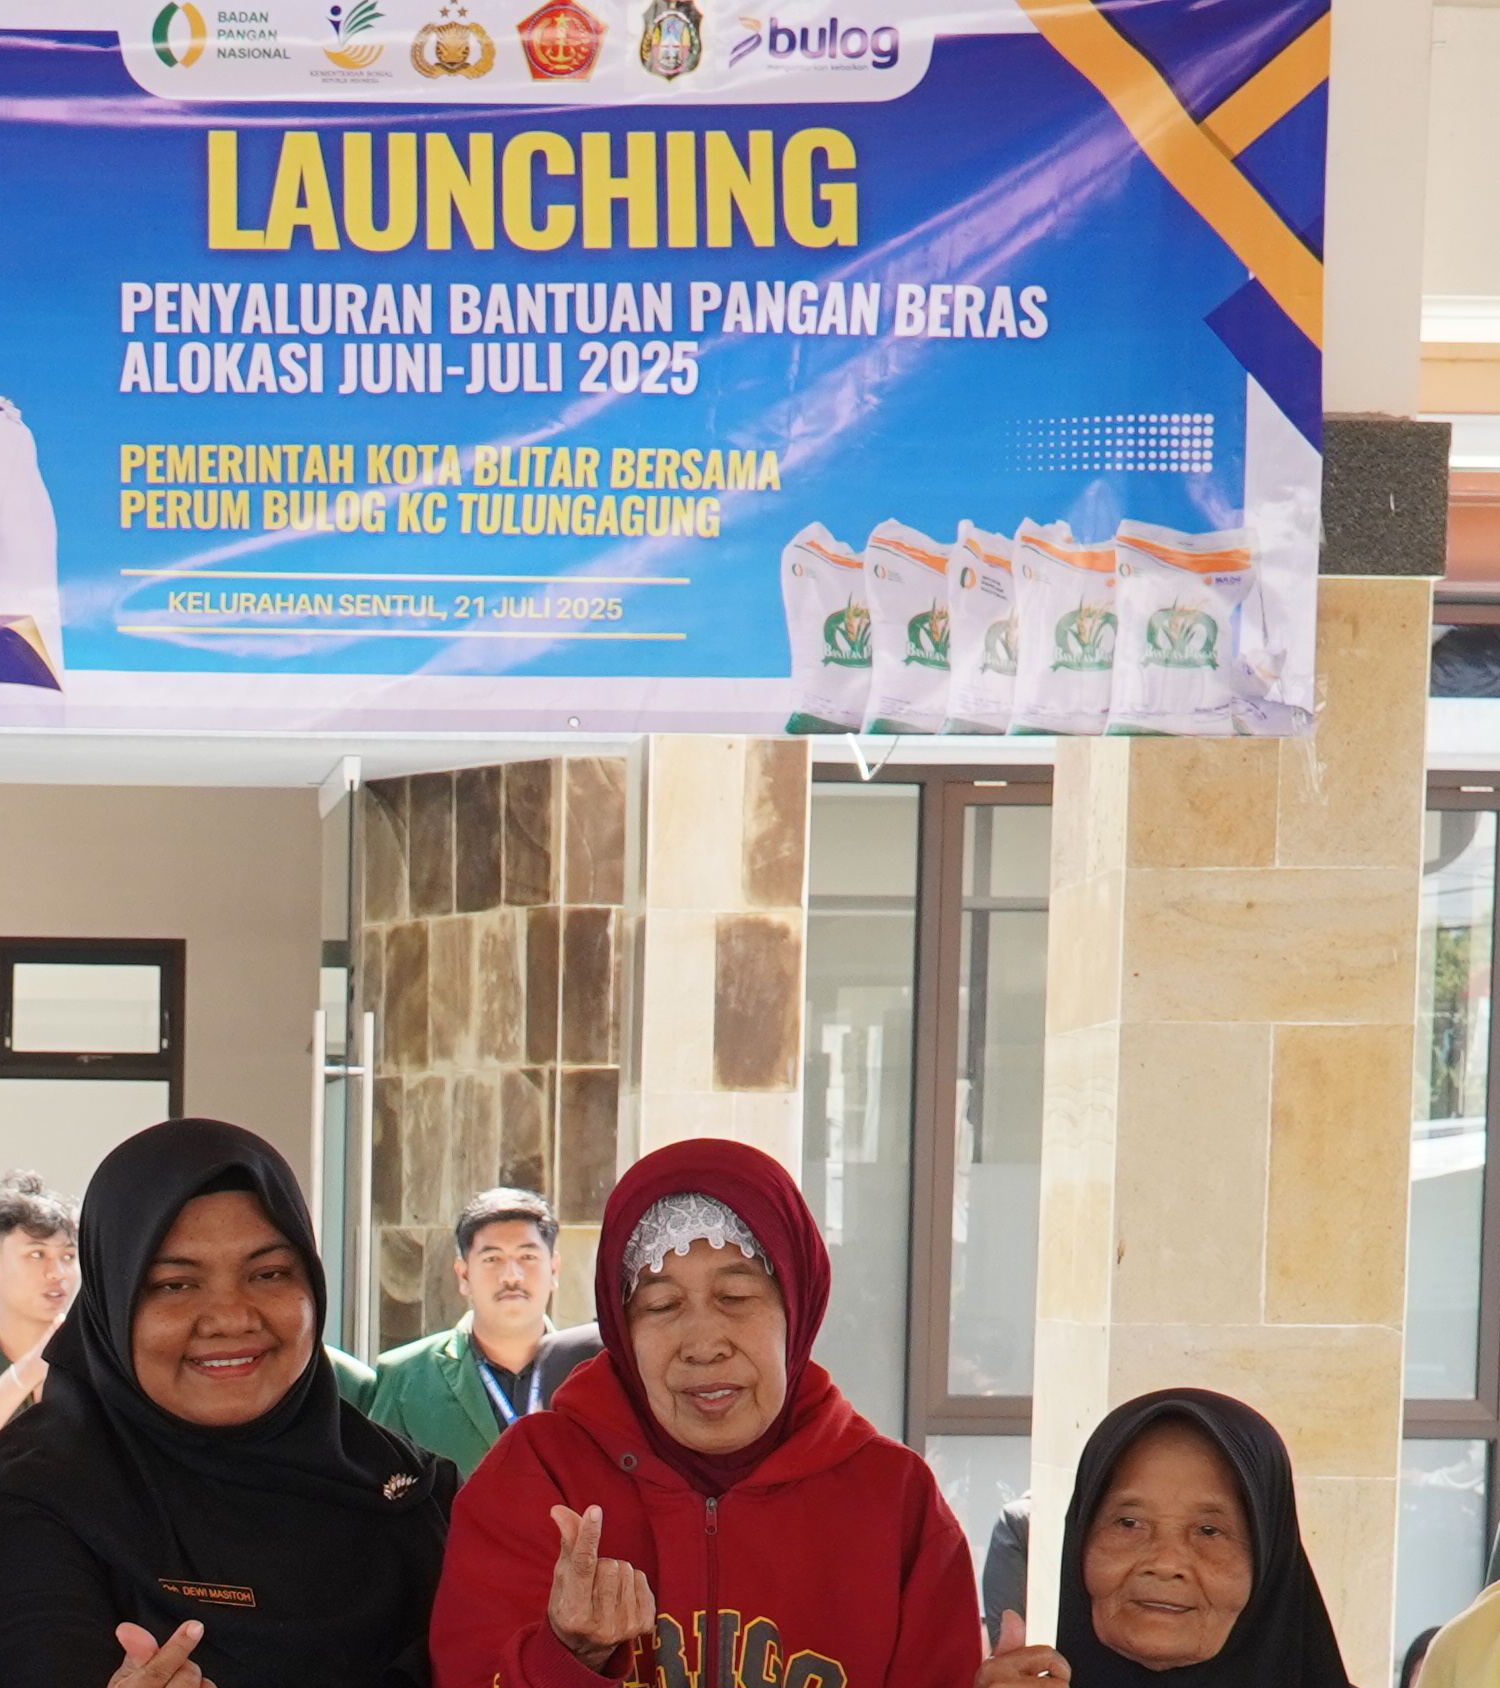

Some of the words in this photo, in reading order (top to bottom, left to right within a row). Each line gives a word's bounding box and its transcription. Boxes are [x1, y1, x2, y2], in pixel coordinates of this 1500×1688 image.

[218, 12, 269, 23] BADAN
[218, 30, 278, 41] PANGAN
[217, 48, 291, 60] NASIONAL
[769, 17, 900, 69] bulog
[207, 127, 858, 252] LAUNCHING
[121, 282, 432, 335] PENYALURAN
[449, 282, 673, 335] BANTUAN
[690, 281, 881, 336] PANGAN
[894, 284, 1049, 338] BERAS
[119, 342, 323, 393] ALOKASI
[338, 342, 562, 394] JUNI-JULI
[579, 341, 699, 395] 2025
[120, 444, 354, 485] PEMERINTAH
[367, 445, 461, 486] KOTA
[473, 446, 600, 488] BLITAR
[610, 448, 781, 491] BERSAMA
[120, 490, 250, 530] PERUM
[263, 491, 385, 533] BULOG
[397, 492, 447, 534] KC
[458, 493, 721, 538] TULUNGAGUNG
[168, 592, 335, 617] KELURAHAN
[338, 594, 447, 621] SENTUL,
[454, 595, 485, 619] 21
[491, 596, 551, 620] JULI
[556, 597, 623, 621] 2025
[182, 1586, 208, 1597] DEWI
[208, 1589, 252, 1602] MASITOH
